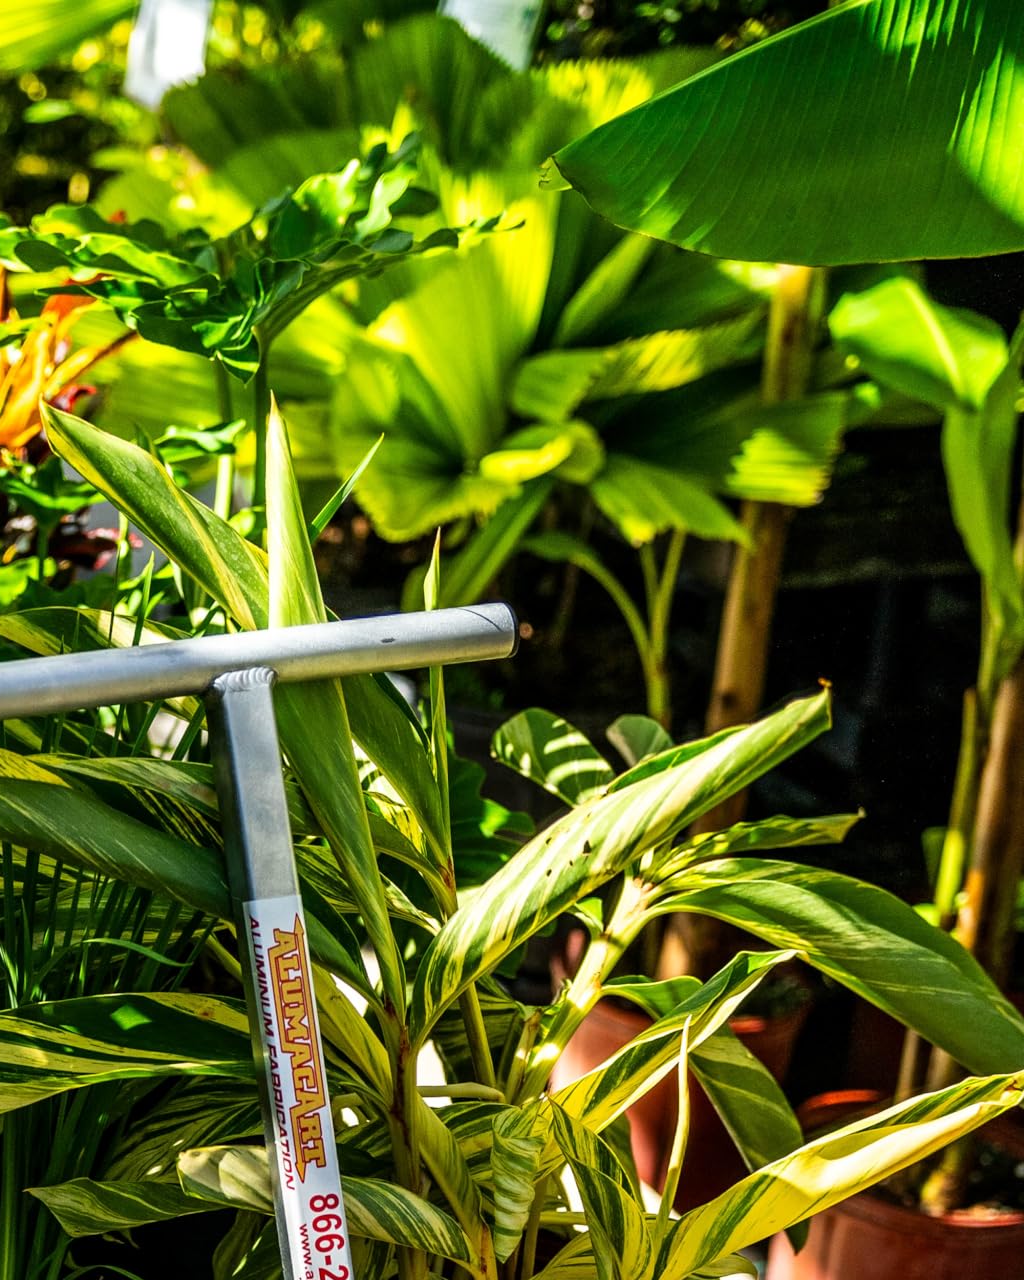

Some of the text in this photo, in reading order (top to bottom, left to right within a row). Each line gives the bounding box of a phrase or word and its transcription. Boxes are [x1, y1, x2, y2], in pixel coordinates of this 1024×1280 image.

[249, 915, 296, 1190] ALUMINUM FABRICATION
[268, 927, 327, 1169] ALUMACART
